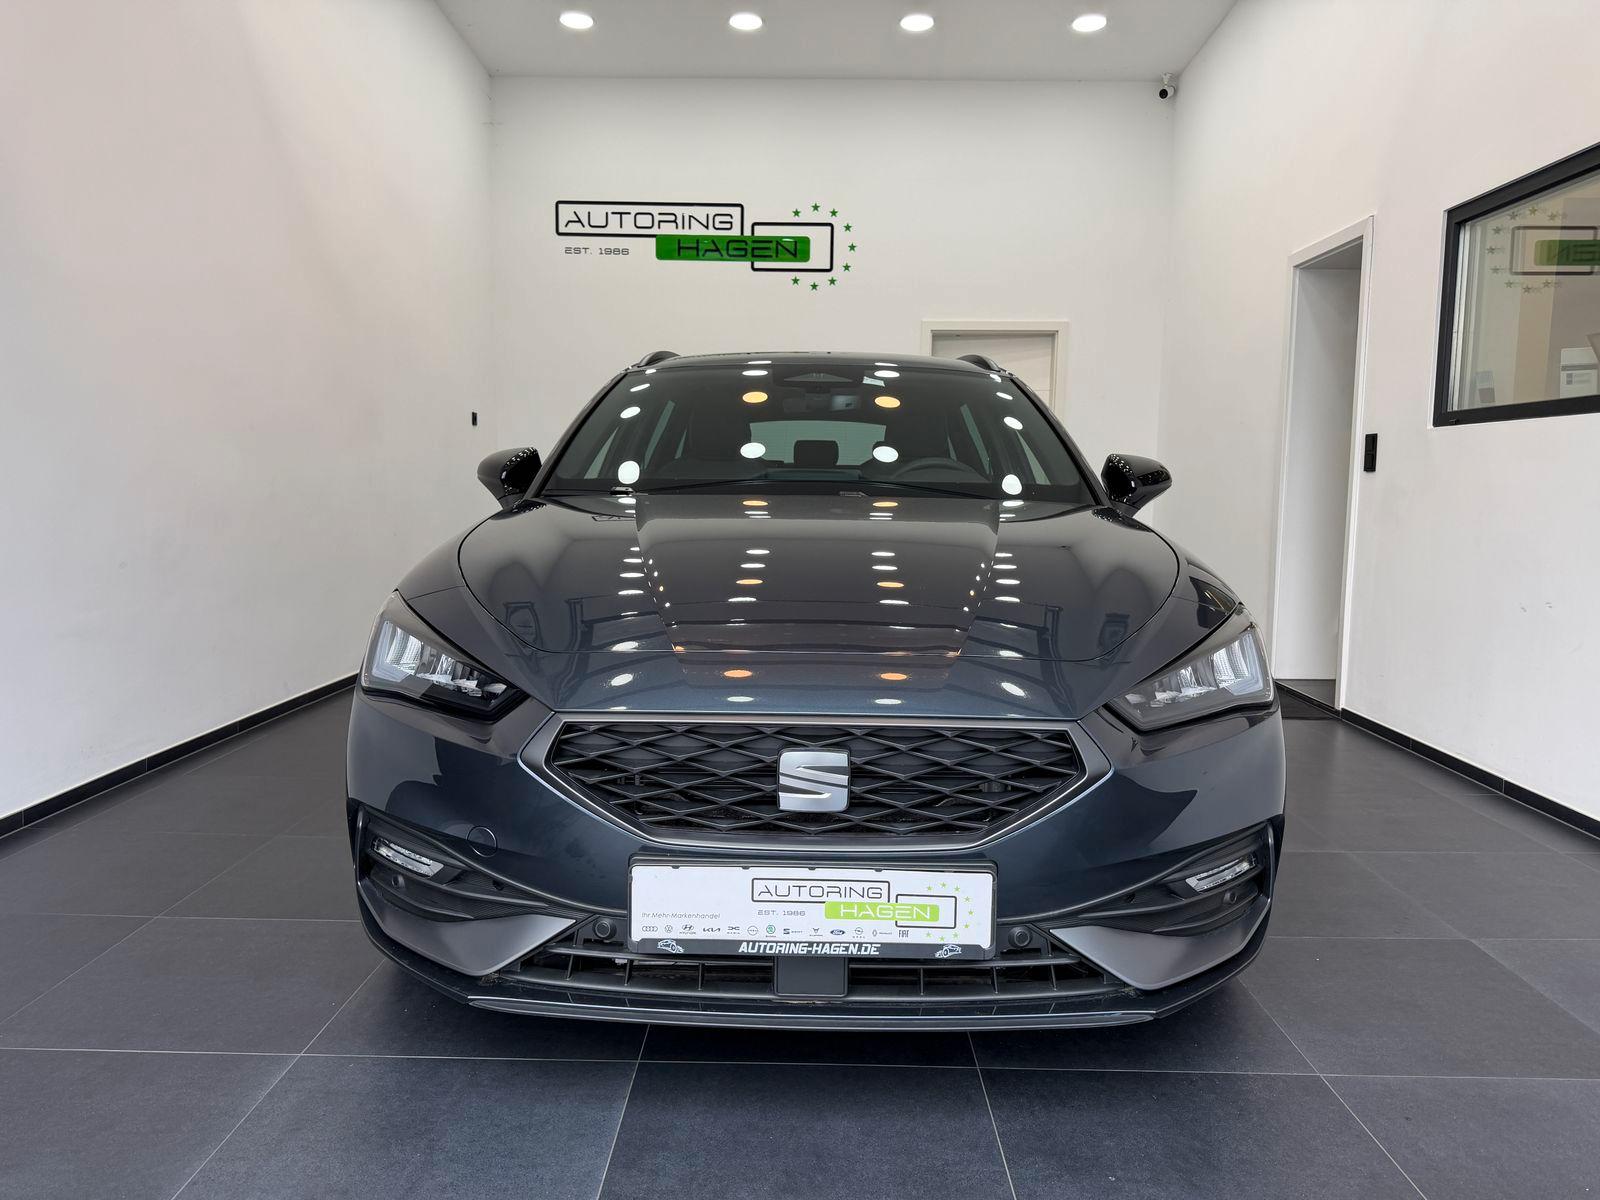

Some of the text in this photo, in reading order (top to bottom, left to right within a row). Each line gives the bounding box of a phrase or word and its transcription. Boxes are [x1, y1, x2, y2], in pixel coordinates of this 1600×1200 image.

[564, 210, 734, 230] AUTORING
[564, 246, 630, 256] EST. 1986
[677, 239, 798, 258] HAGEN
[757, 884, 883, 899] AUTORING
[840, 903, 931, 919] HAGEN
[738, 941, 881, 955] AUTORING-HAGEN.DE
